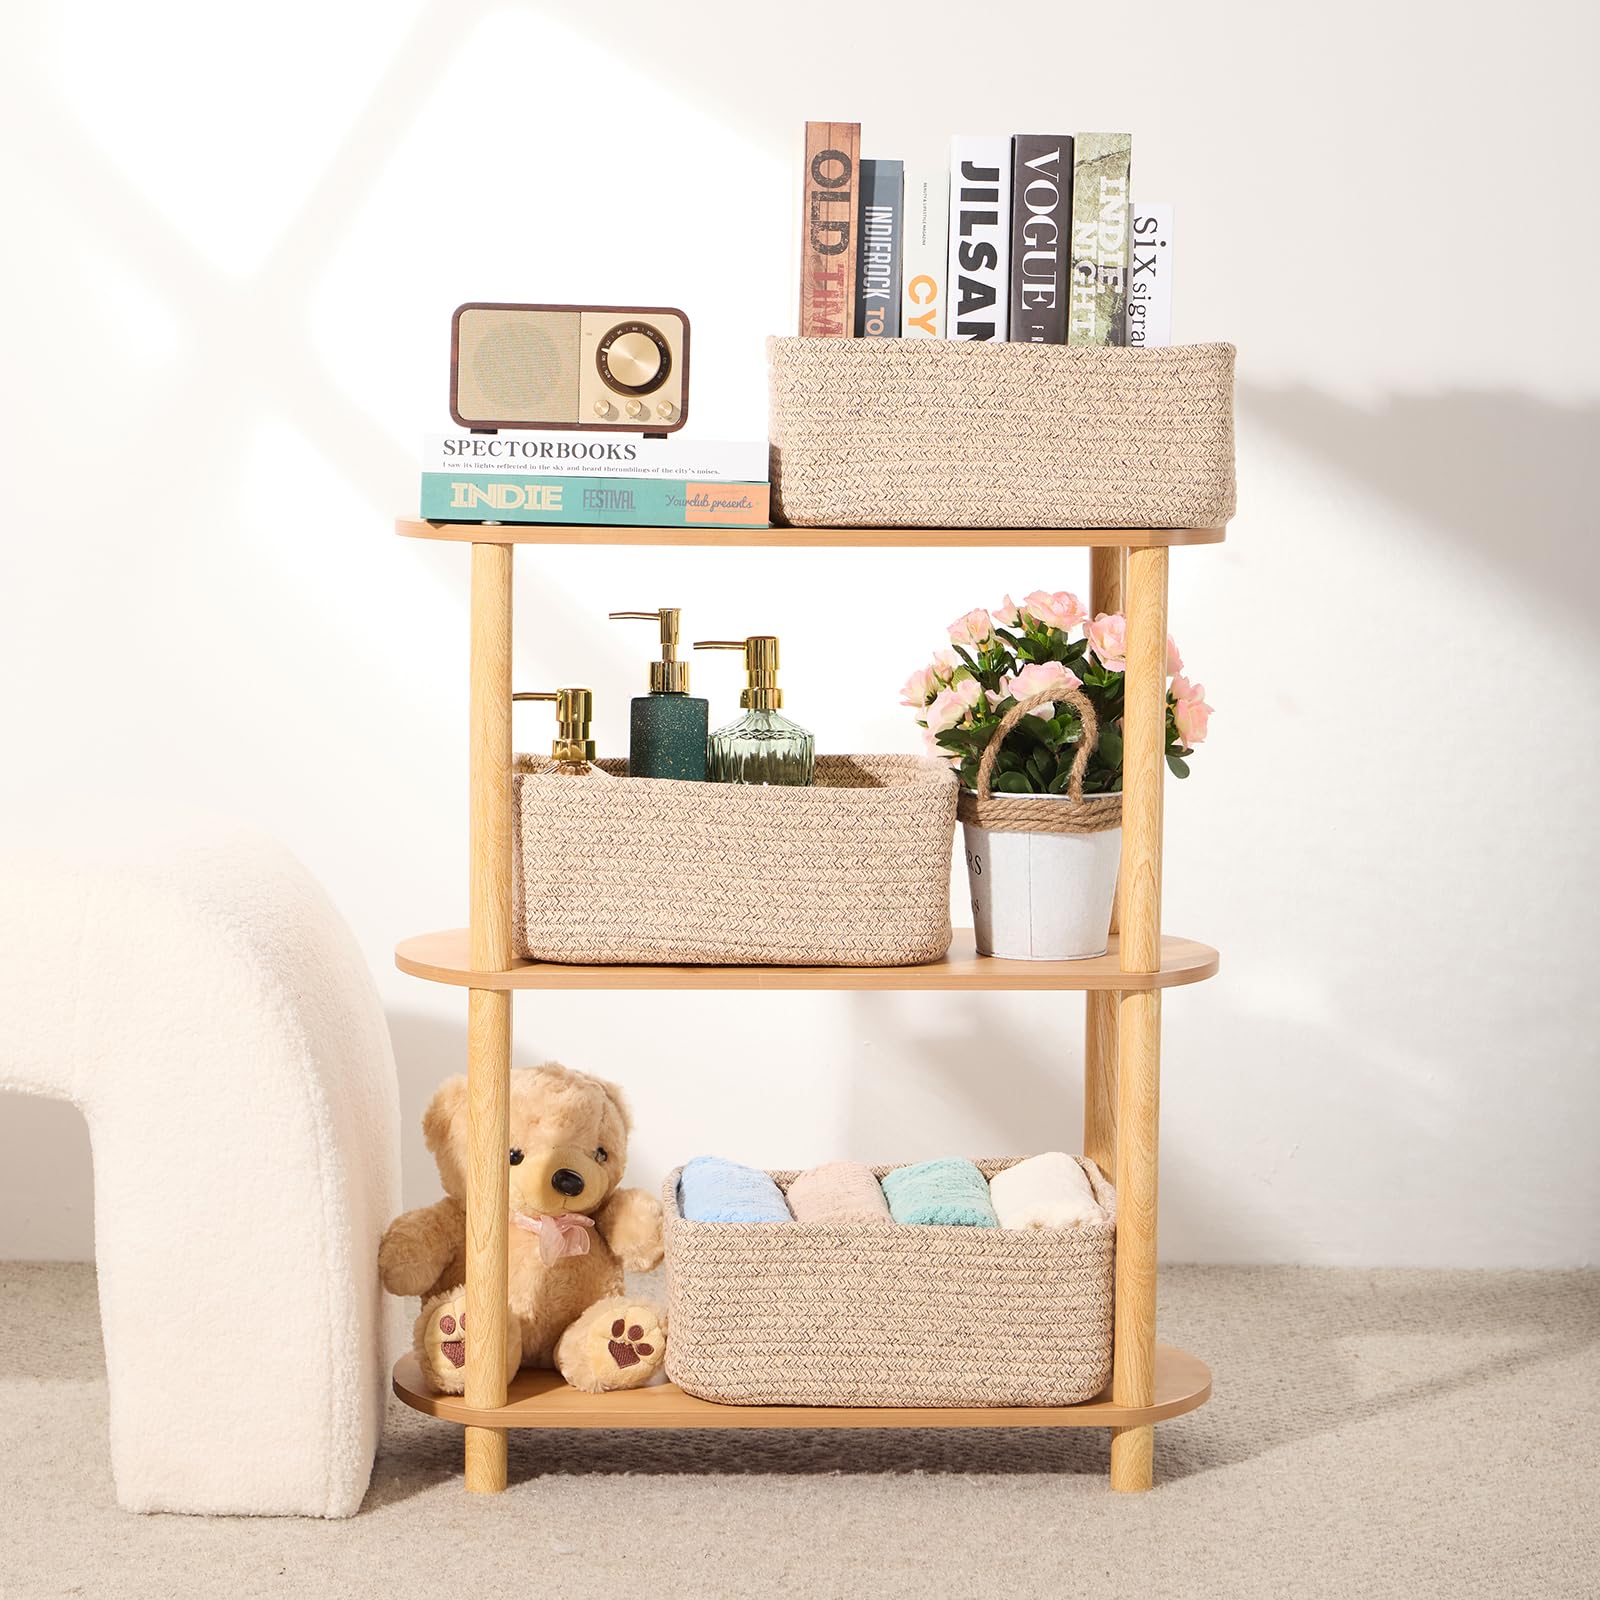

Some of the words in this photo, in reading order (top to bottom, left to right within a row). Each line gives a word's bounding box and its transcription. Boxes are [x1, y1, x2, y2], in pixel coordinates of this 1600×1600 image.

[811, 149, 851, 256] OLD
[1021, 147, 1061, 311] VOGUE
[1096, 175, 1126, 294] INDIE
[862, 206, 893, 300] INDIEROCK
[1072, 219, 1099, 338] NIGHT
[812, 262, 845, 338] TIM
[866, 306, 886, 338] TO
[1128, 282, 1152, 348] sigra
[443, 439, 637, 461] SPECTORBOOKS
[463, 461, 473, 469] its
[474, 462, 495, 470] lights
[496, 462, 528, 470] reflected
[538, 463, 551, 471] the
[552, 464, 564, 472] sky
[451, 482, 563, 510] INDIE
[582, 488, 636, 510] FESTIVAL
[710, 495, 753, 513] presents
